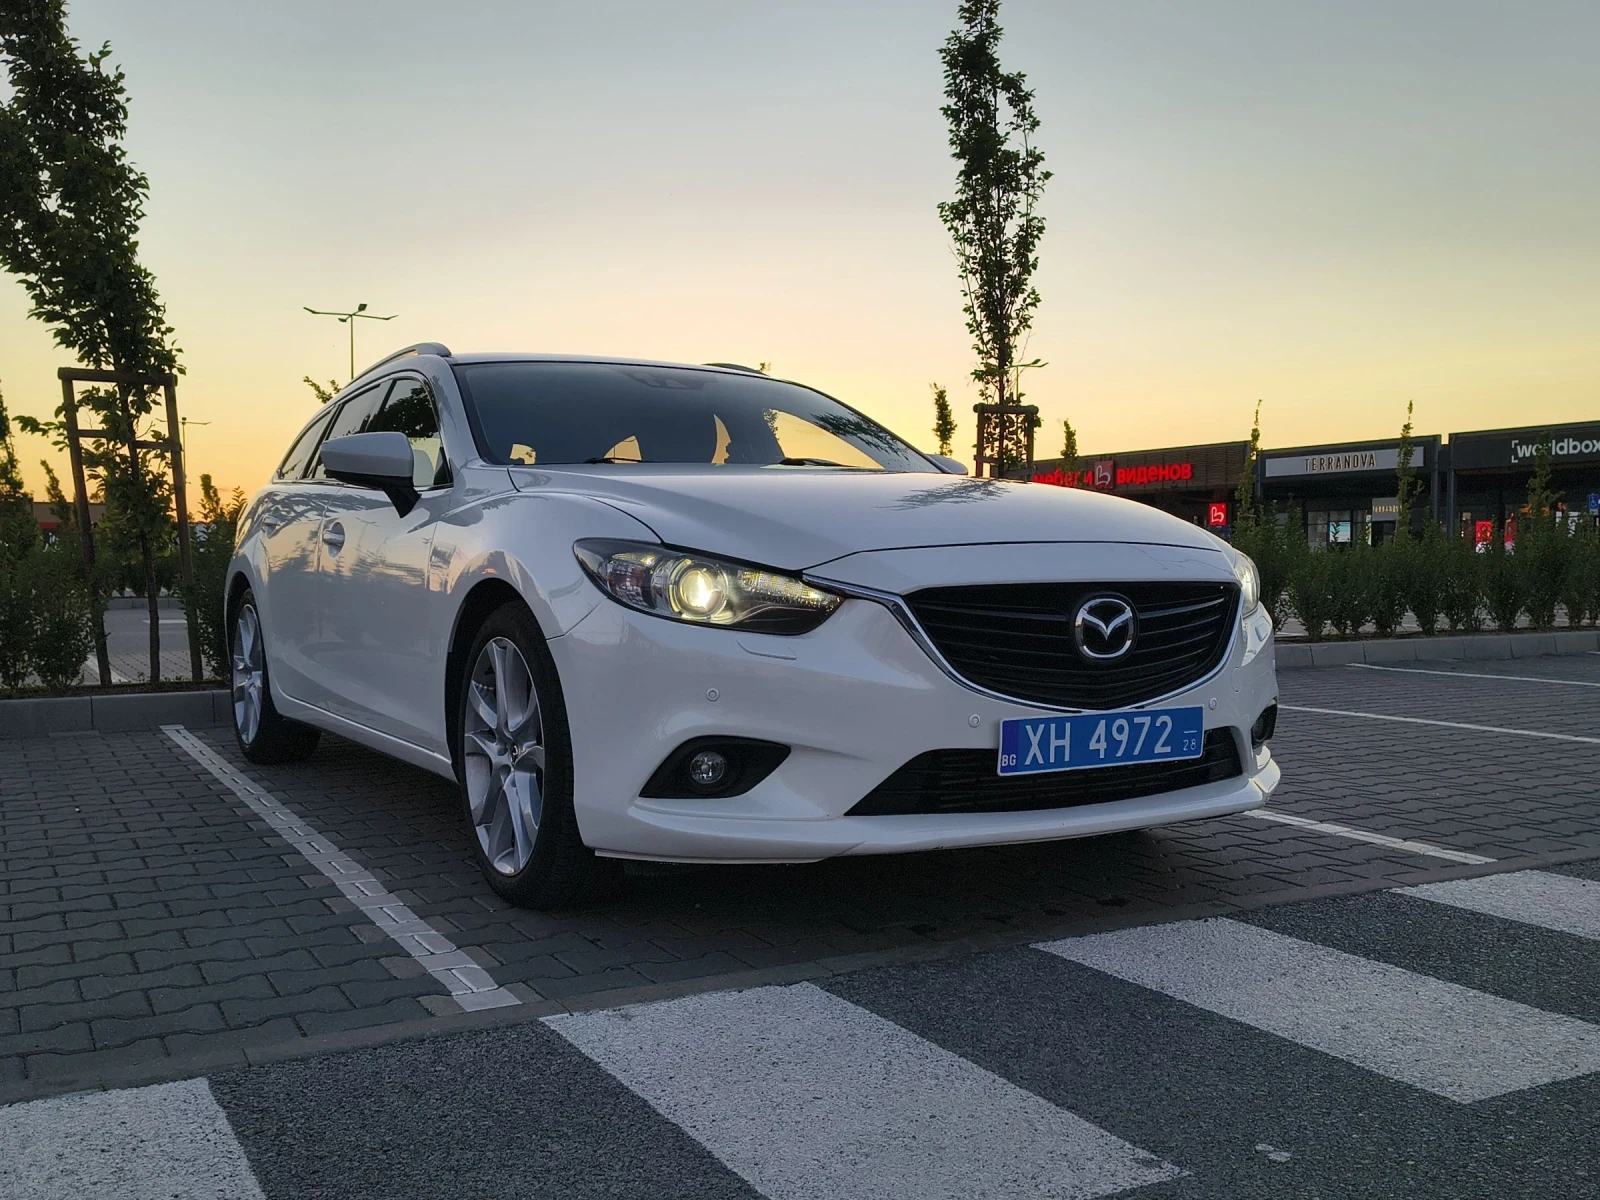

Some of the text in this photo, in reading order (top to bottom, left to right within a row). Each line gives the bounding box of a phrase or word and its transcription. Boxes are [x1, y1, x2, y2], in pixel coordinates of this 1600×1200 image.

[1516, 438, 1600, 458] woldbox
[1304, 452, 1377, 472] TERRANOVA
[1116, 462, 1194, 485] виденов
[1024, 715, 1173, 766] XH 4972
[1182, 738, 1198, 751] 28
[1001, 753, 1017, 767] BG
